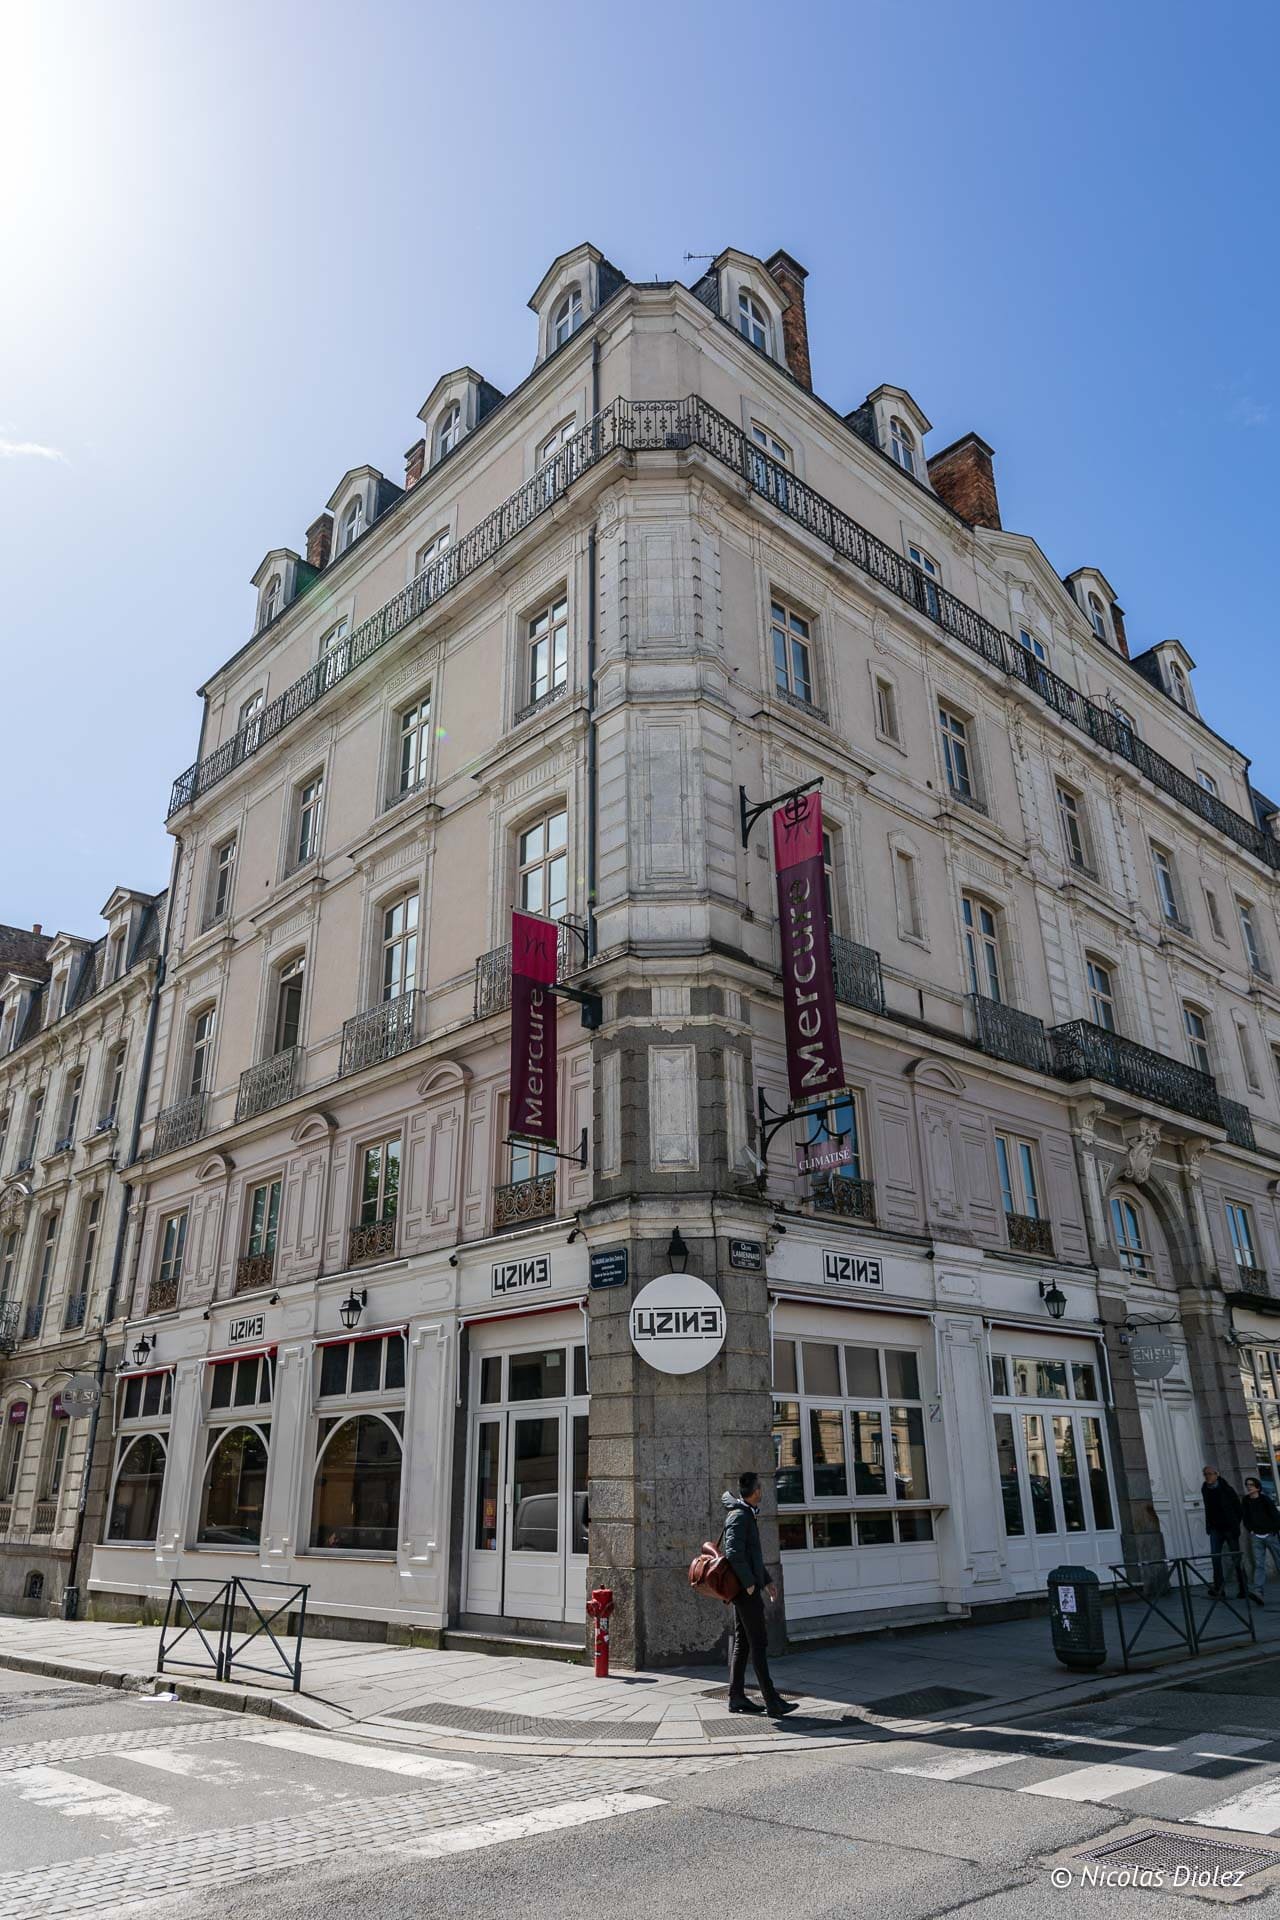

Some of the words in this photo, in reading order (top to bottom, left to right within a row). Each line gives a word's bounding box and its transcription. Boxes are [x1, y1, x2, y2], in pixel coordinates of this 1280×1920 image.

[788, 877, 834, 1088] Mercure
[525, 988, 544, 1127] Mercure
[799, 1146, 851, 1170] CLIMATISÉ
